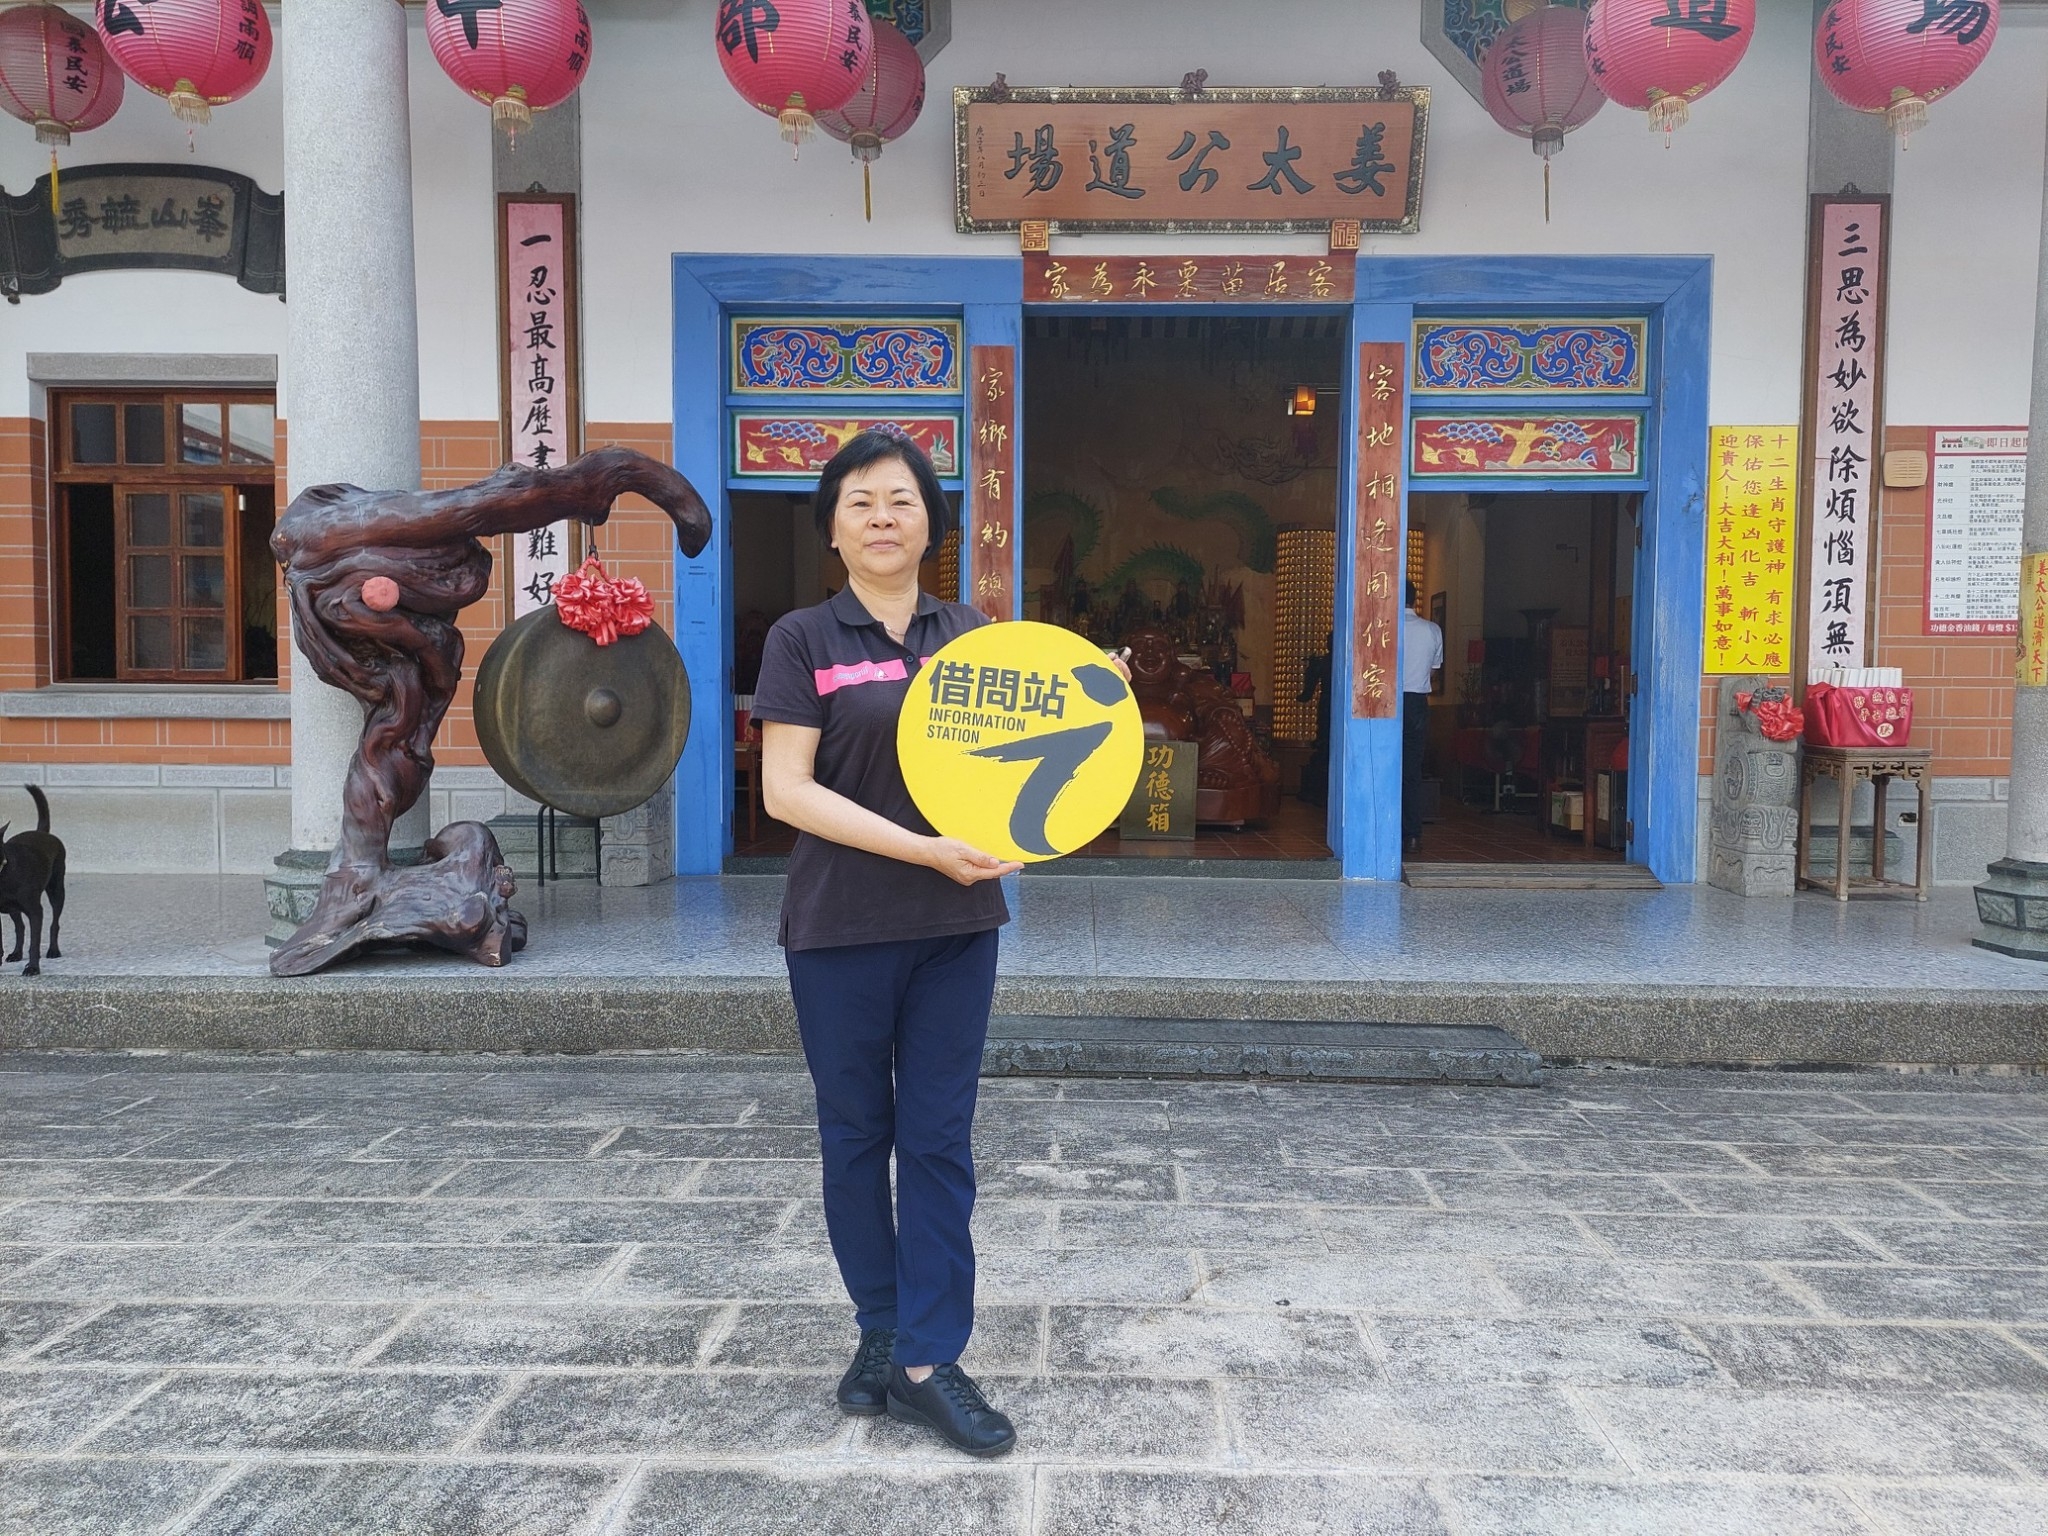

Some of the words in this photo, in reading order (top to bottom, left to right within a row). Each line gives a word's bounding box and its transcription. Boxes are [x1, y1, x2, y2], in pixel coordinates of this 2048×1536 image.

[1003, 121, 1397, 198] 姜太公道場
[1819, 222, 1870, 668] 三思為妙欲除煩惱須無
[977, 367, 1009, 623] 家鄉有約總
[1739, 434, 1766, 587] 保佑您逢凶化吉
[1764, 434, 1790, 575] 十二生肖守護神
[1736, 606, 1760, 667] 斬小人
[1761, 589, 1785, 667] 有求必應
[928, 659, 1069, 720] 借問站
[928, 707, 1027, 733] INFORMATION
[926, 724, 981, 745] STATION
[1146, 744, 1175, 834] 功德箱
